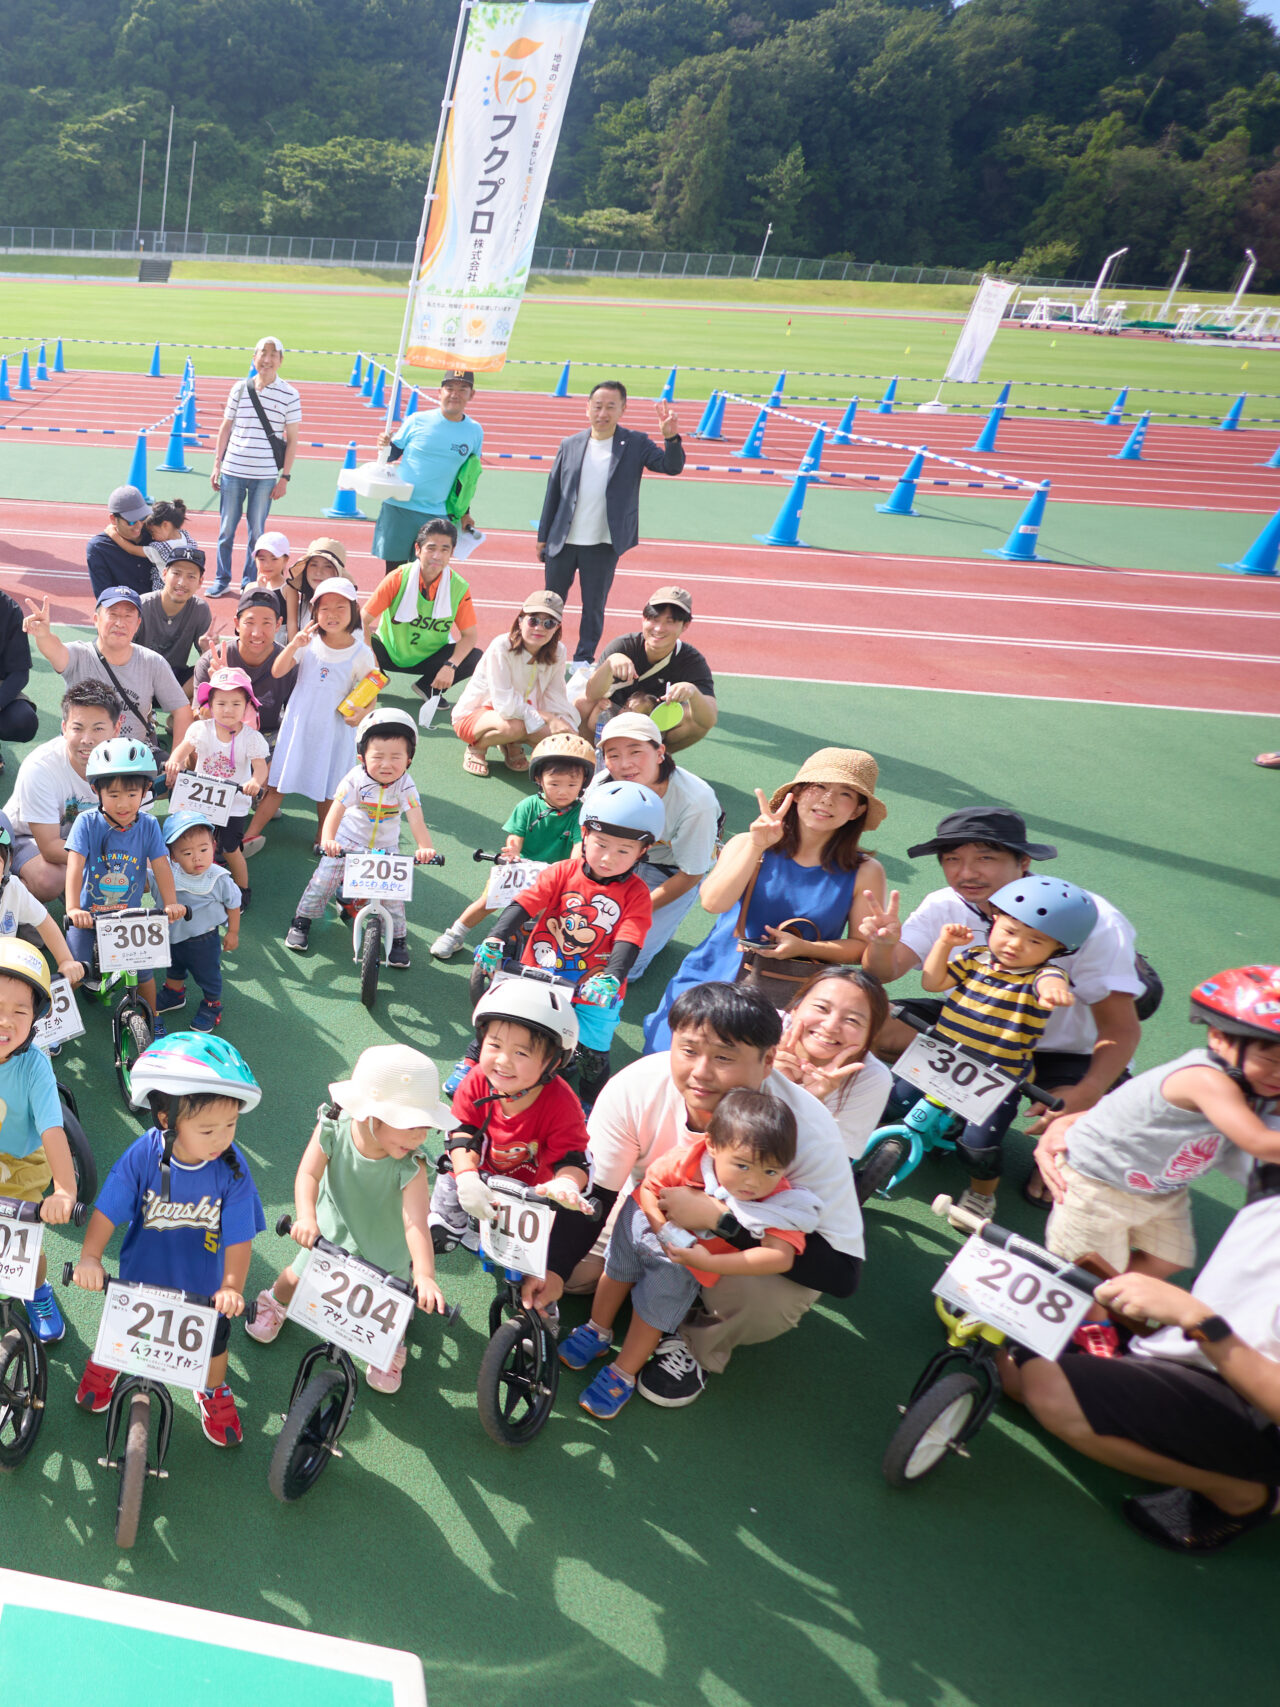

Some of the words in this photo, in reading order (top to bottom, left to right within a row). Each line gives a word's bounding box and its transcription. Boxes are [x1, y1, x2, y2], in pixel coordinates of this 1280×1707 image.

[470, 114, 518, 234] フクプロ
[466, 238, 485, 283] 株式会社
[410, 614, 454, 633] asics
[410, 632, 421, 645] 2
[187, 781, 228, 809] 211
[360, 859, 408, 882] 205
[113, 922, 165, 950] 308
[928, 1048, 1006, 1098] 307
[321, 1271, 400, 1335] 204
[976, 1258, 1074, 1324] 208
[126, 1301, 205, 1353] 216
[322, 1304, 348, 1326] アサノ
[351, 1323, 376, 1345] エマ
